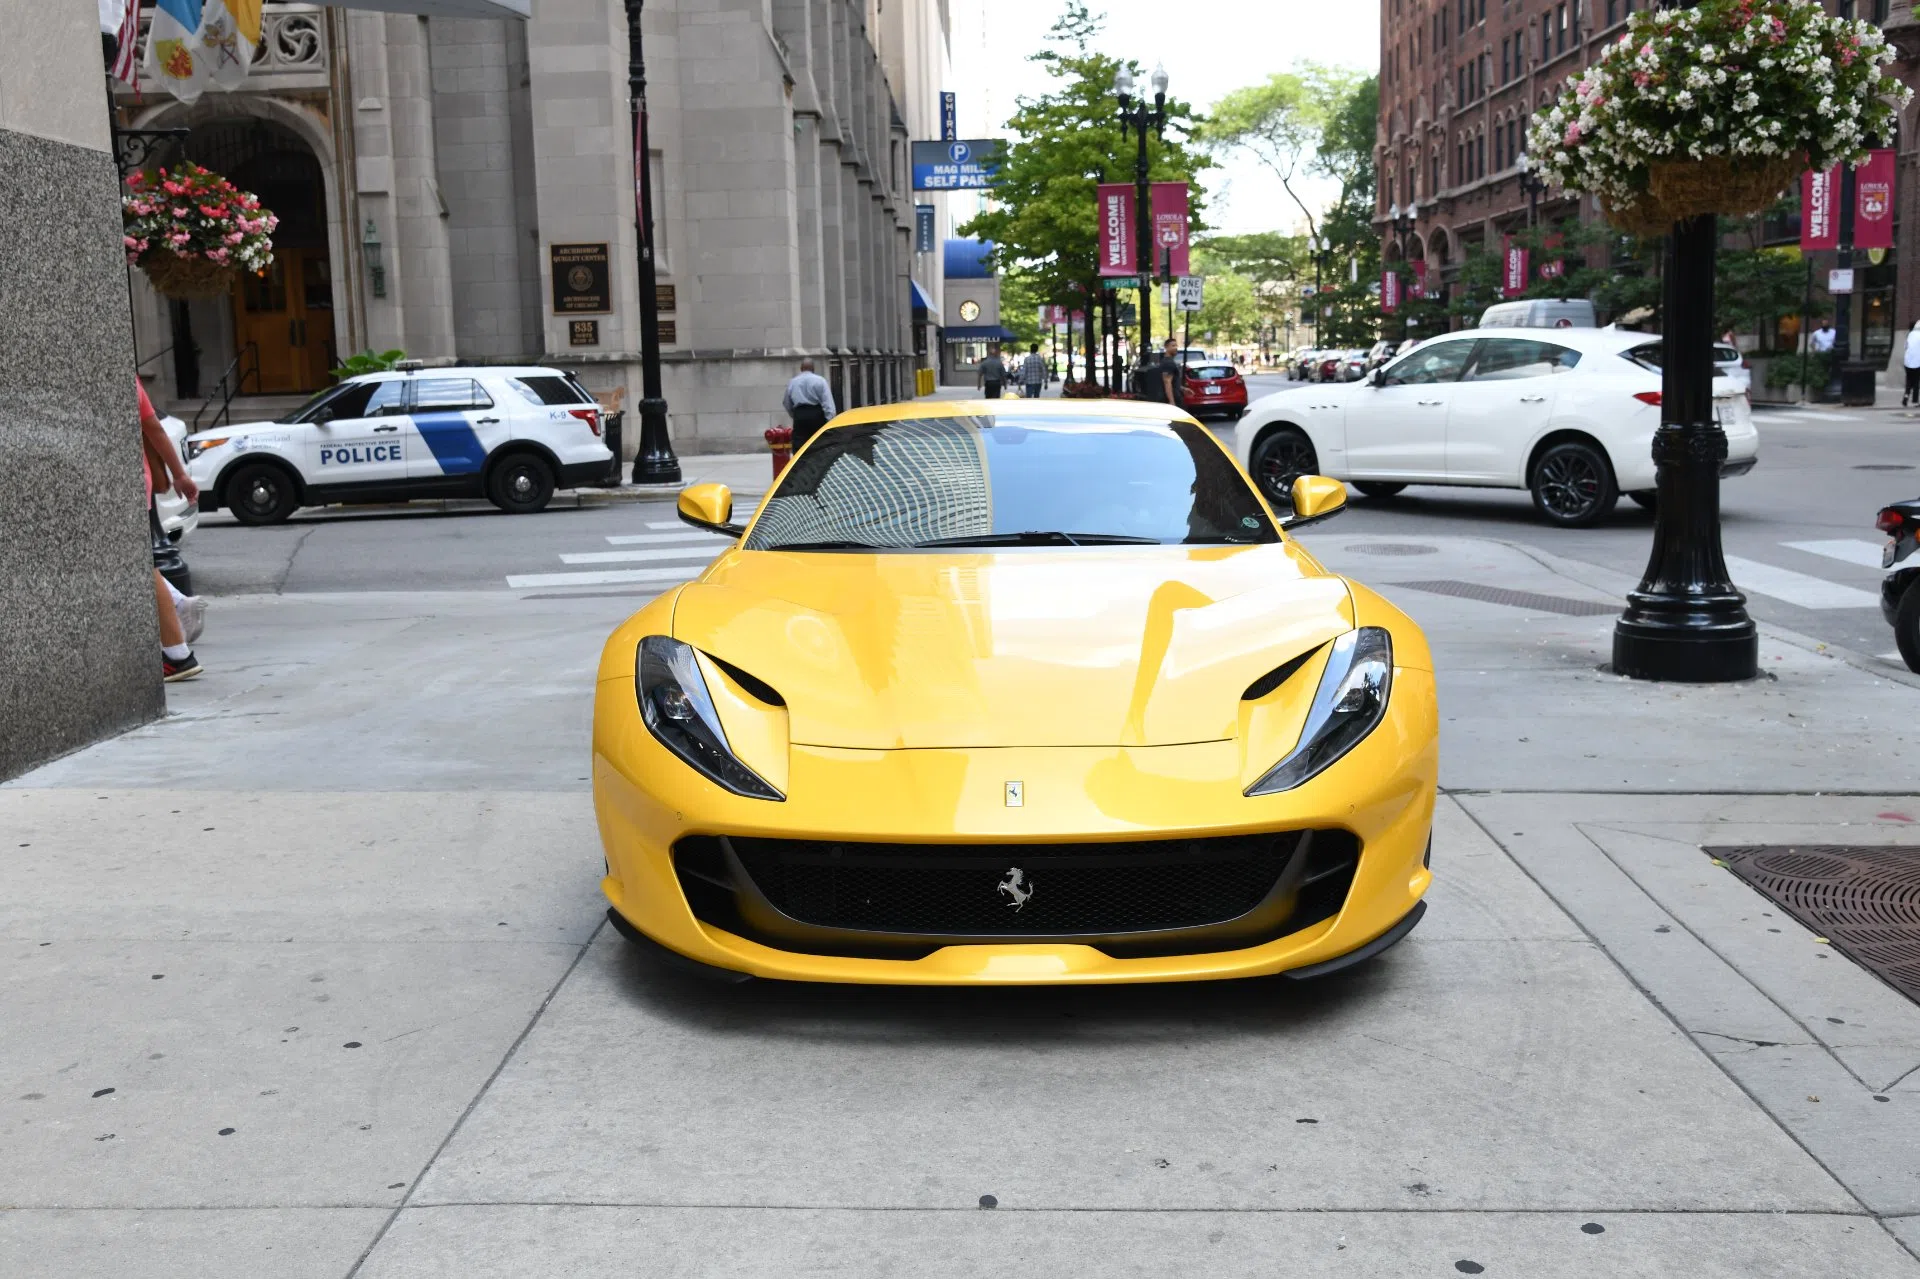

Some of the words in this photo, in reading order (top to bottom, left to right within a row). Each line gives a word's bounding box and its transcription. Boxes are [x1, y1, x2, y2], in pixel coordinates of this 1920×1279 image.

[945, 94, 954, 141] GHIRA
[953, 144, 966, 161] P
[934, 164, 958, 175] MAG
[960, 163, 987, 174] MIL
[924, 174, 958, 188] SELF
[960, 173, 996, 187] PAR
[1810, 172, 1824, 238] WELCOM
[1156, 213, 1184, 221] LOYOLA
[1107, 195, 1121, 267] WELCOME
[1180, 279, 1200, 289] ONE
[1180, 288, 1200, 297] WAY
[574, 321, 593, 333] 835
[945, 336, 1000, 344] GHIRARDELLI
[549, 410, 567, 420] K-9
[320, 445, 403, 466] POLICE
